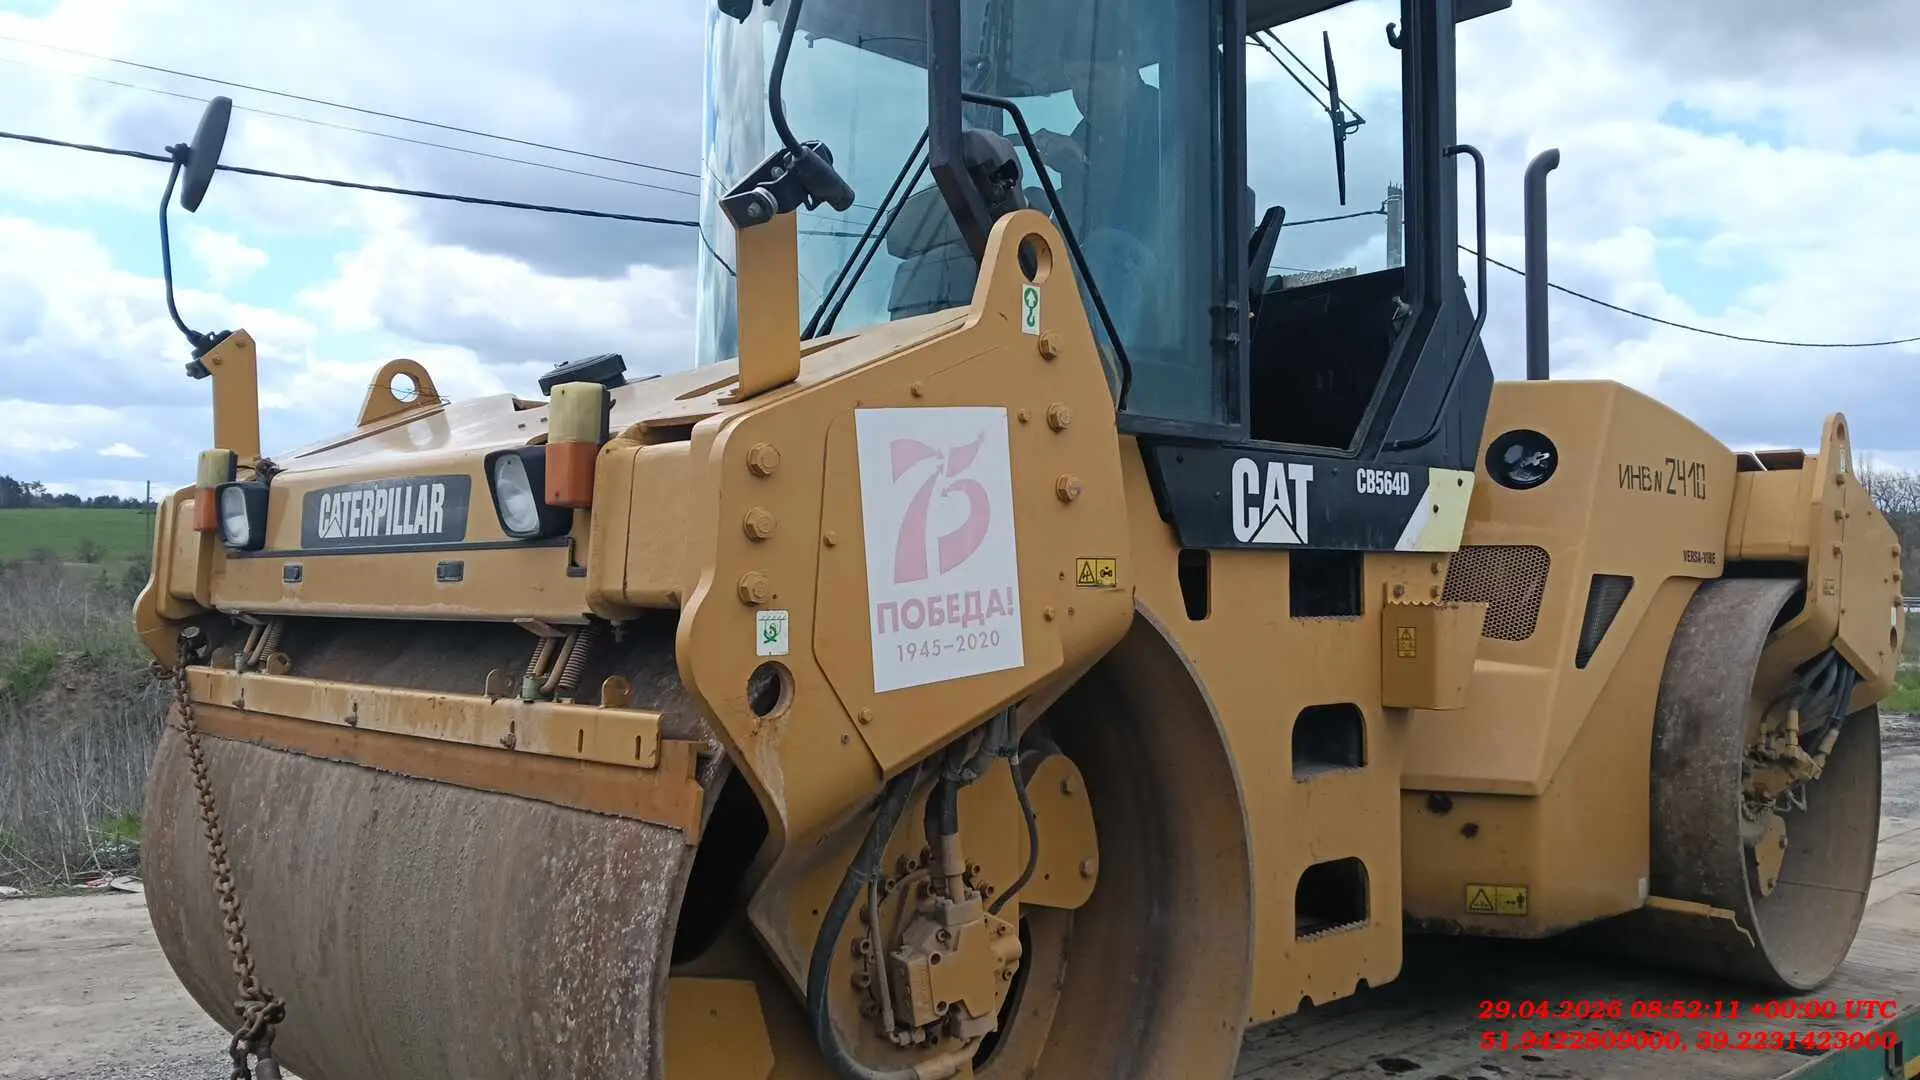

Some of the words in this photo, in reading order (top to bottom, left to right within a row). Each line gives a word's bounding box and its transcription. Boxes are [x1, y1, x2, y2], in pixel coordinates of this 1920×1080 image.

[1231, 457, 1313, 544] CAT
[1356, 467, 1410, 496] CB564D
[1664, 457, 1706, 501] 2410
[318, 483, 445, 539] CATERPILLAR
[876, 586, 1016, 635] ПОБЕДА!
